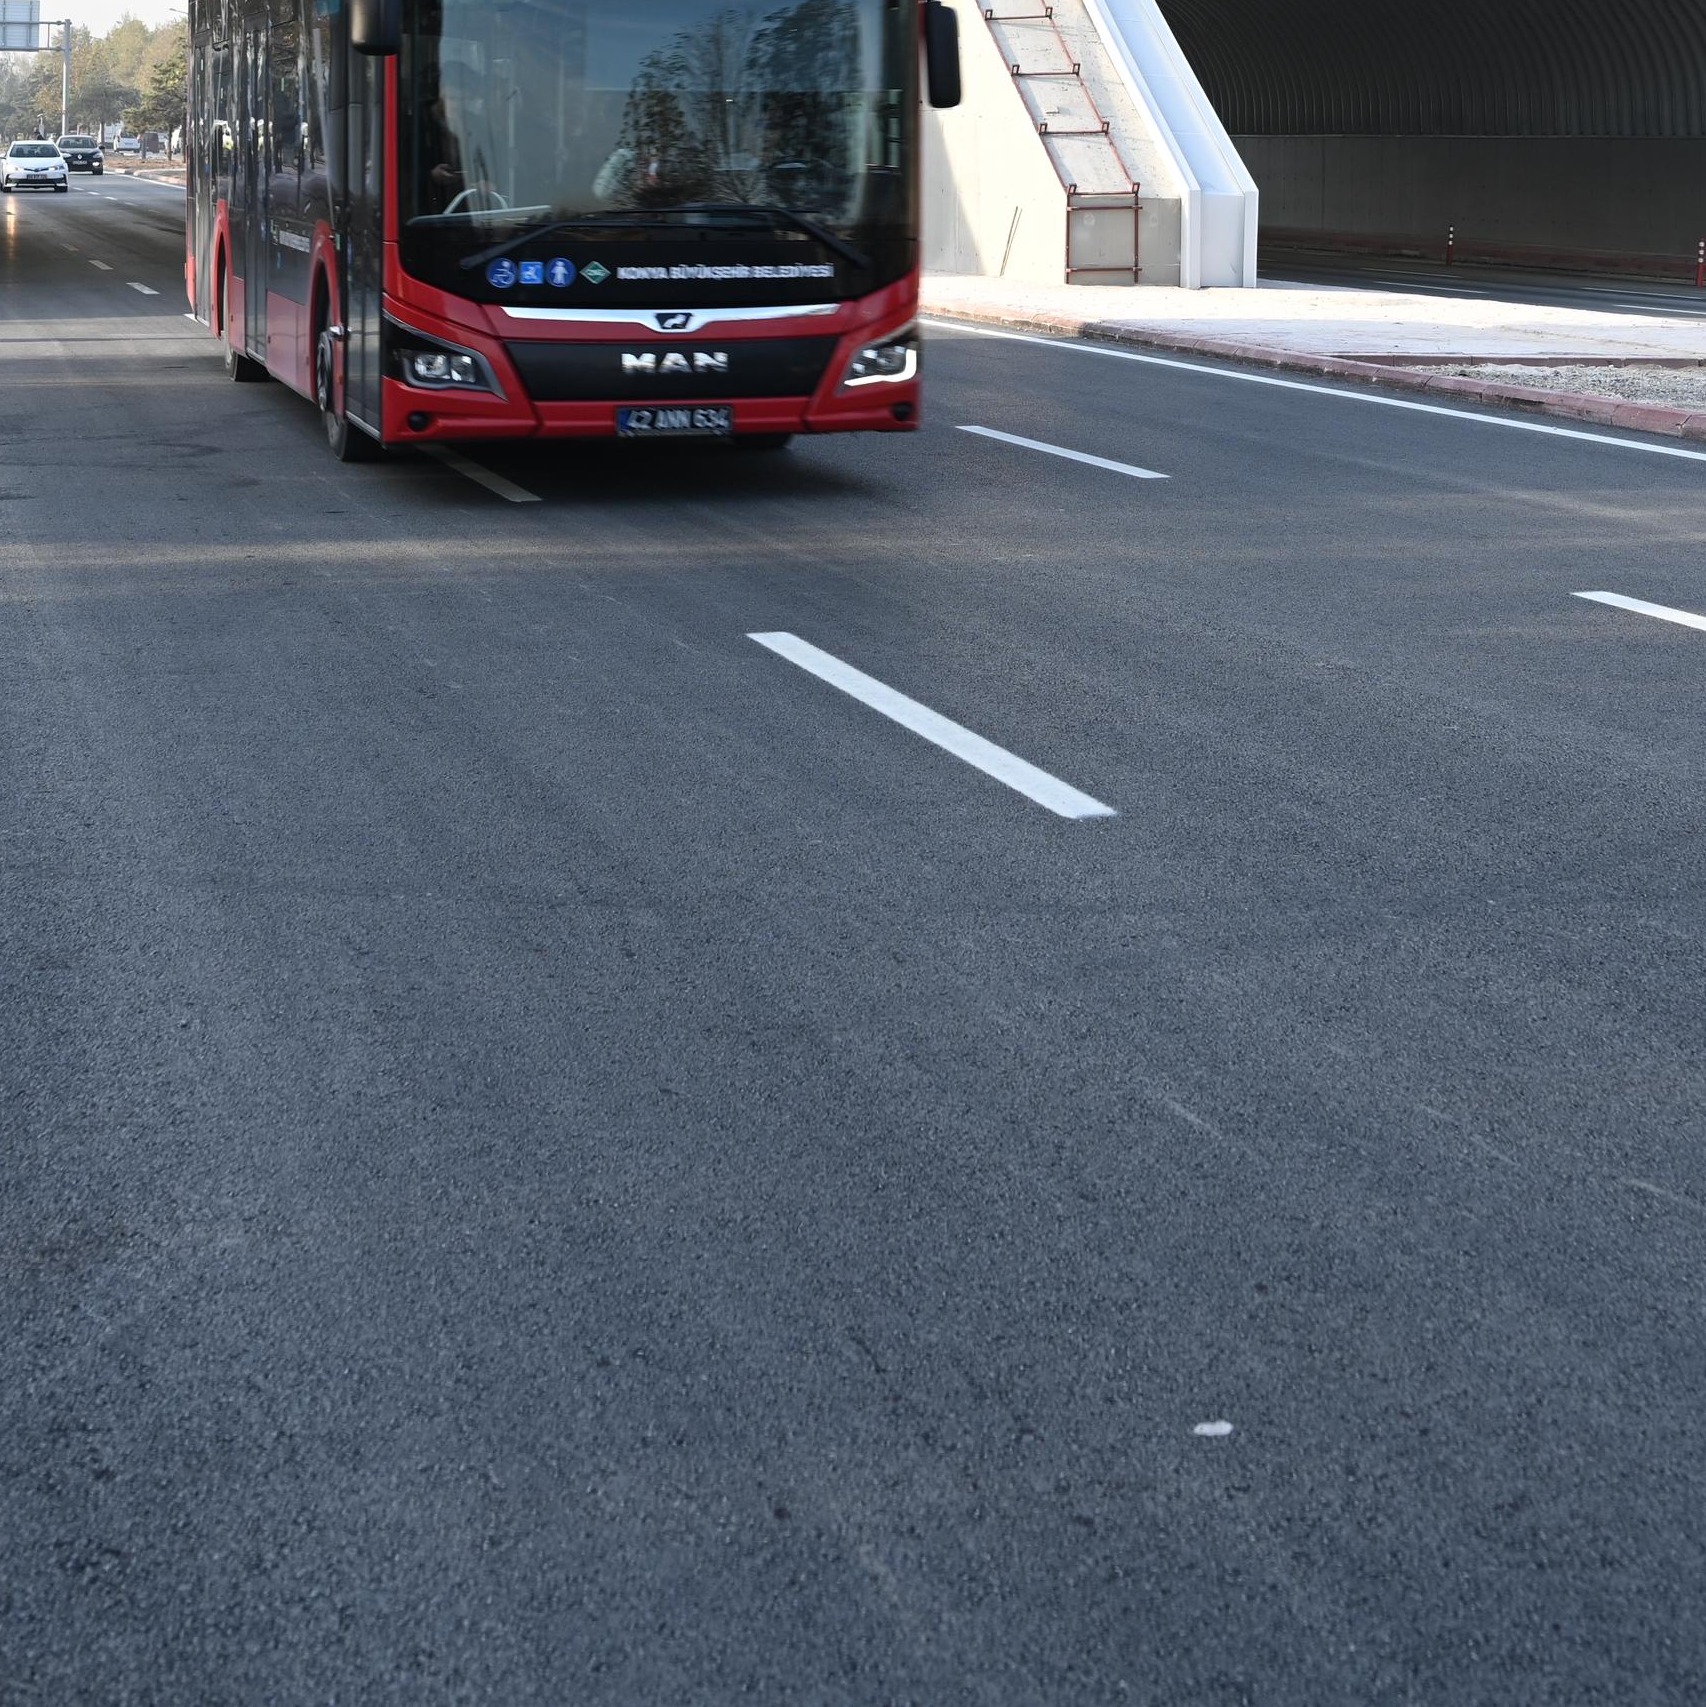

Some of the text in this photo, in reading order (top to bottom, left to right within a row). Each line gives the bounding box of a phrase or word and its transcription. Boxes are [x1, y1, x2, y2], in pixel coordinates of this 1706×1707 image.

[616, 266, 670, 280] KONYA
[621, 351, 729, 374] MAN
[627, 409, 653, 429] 42
[693, 406, 730, 428] 634
